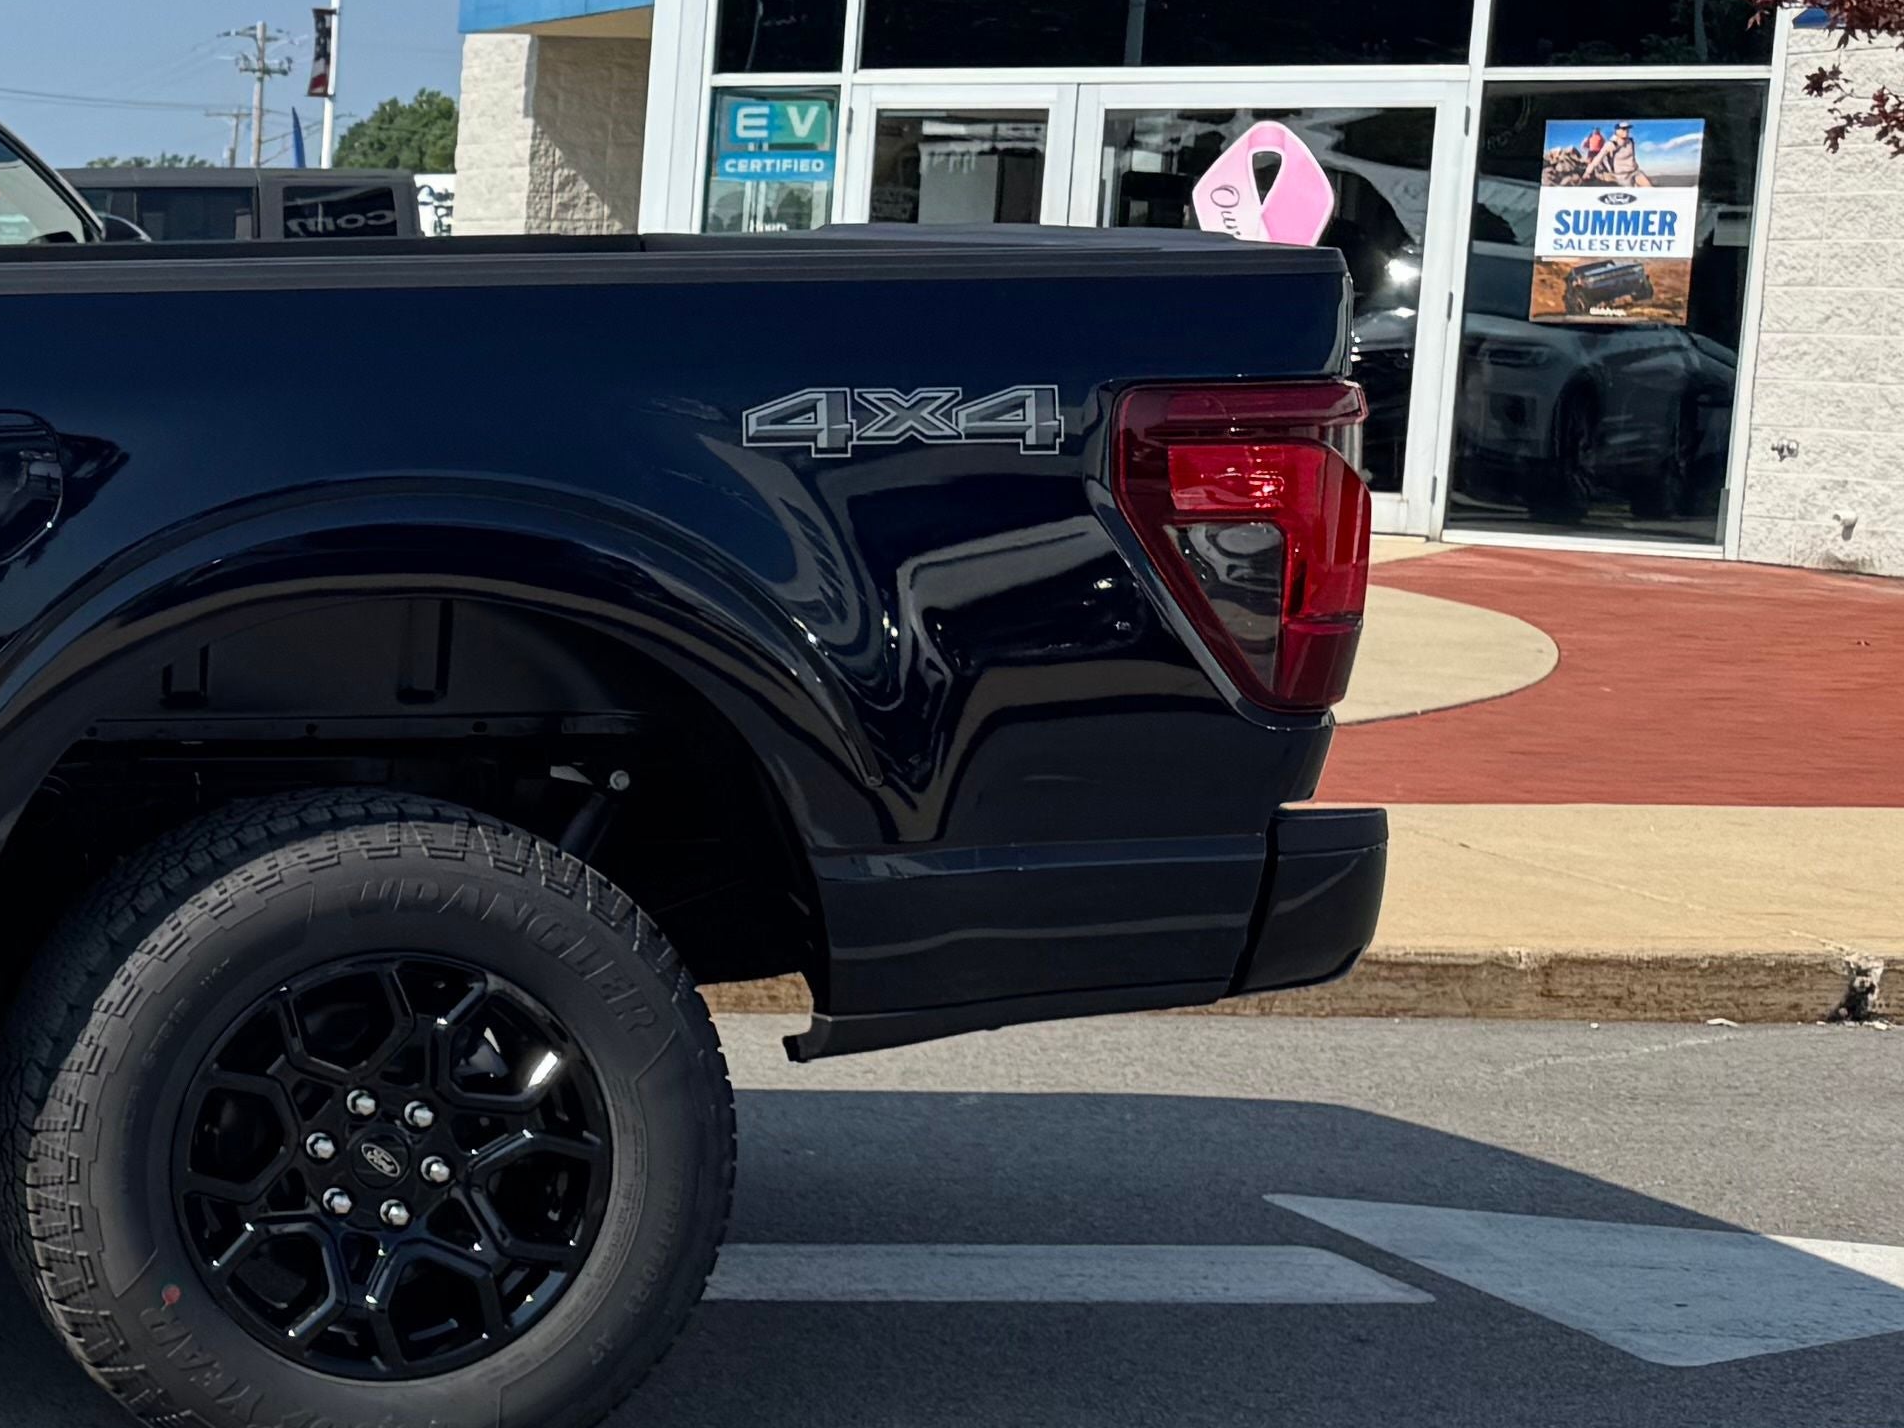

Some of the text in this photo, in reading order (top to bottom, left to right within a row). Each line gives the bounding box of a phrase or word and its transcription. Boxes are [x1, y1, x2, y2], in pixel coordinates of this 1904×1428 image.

[736, 105, 820, 138] EV
[724, 158, 825, 173] CERTIFIED
[1553, 209, 1678, 236] SUMMER
[1553, 239, 1675, 251] SALES EVENT
